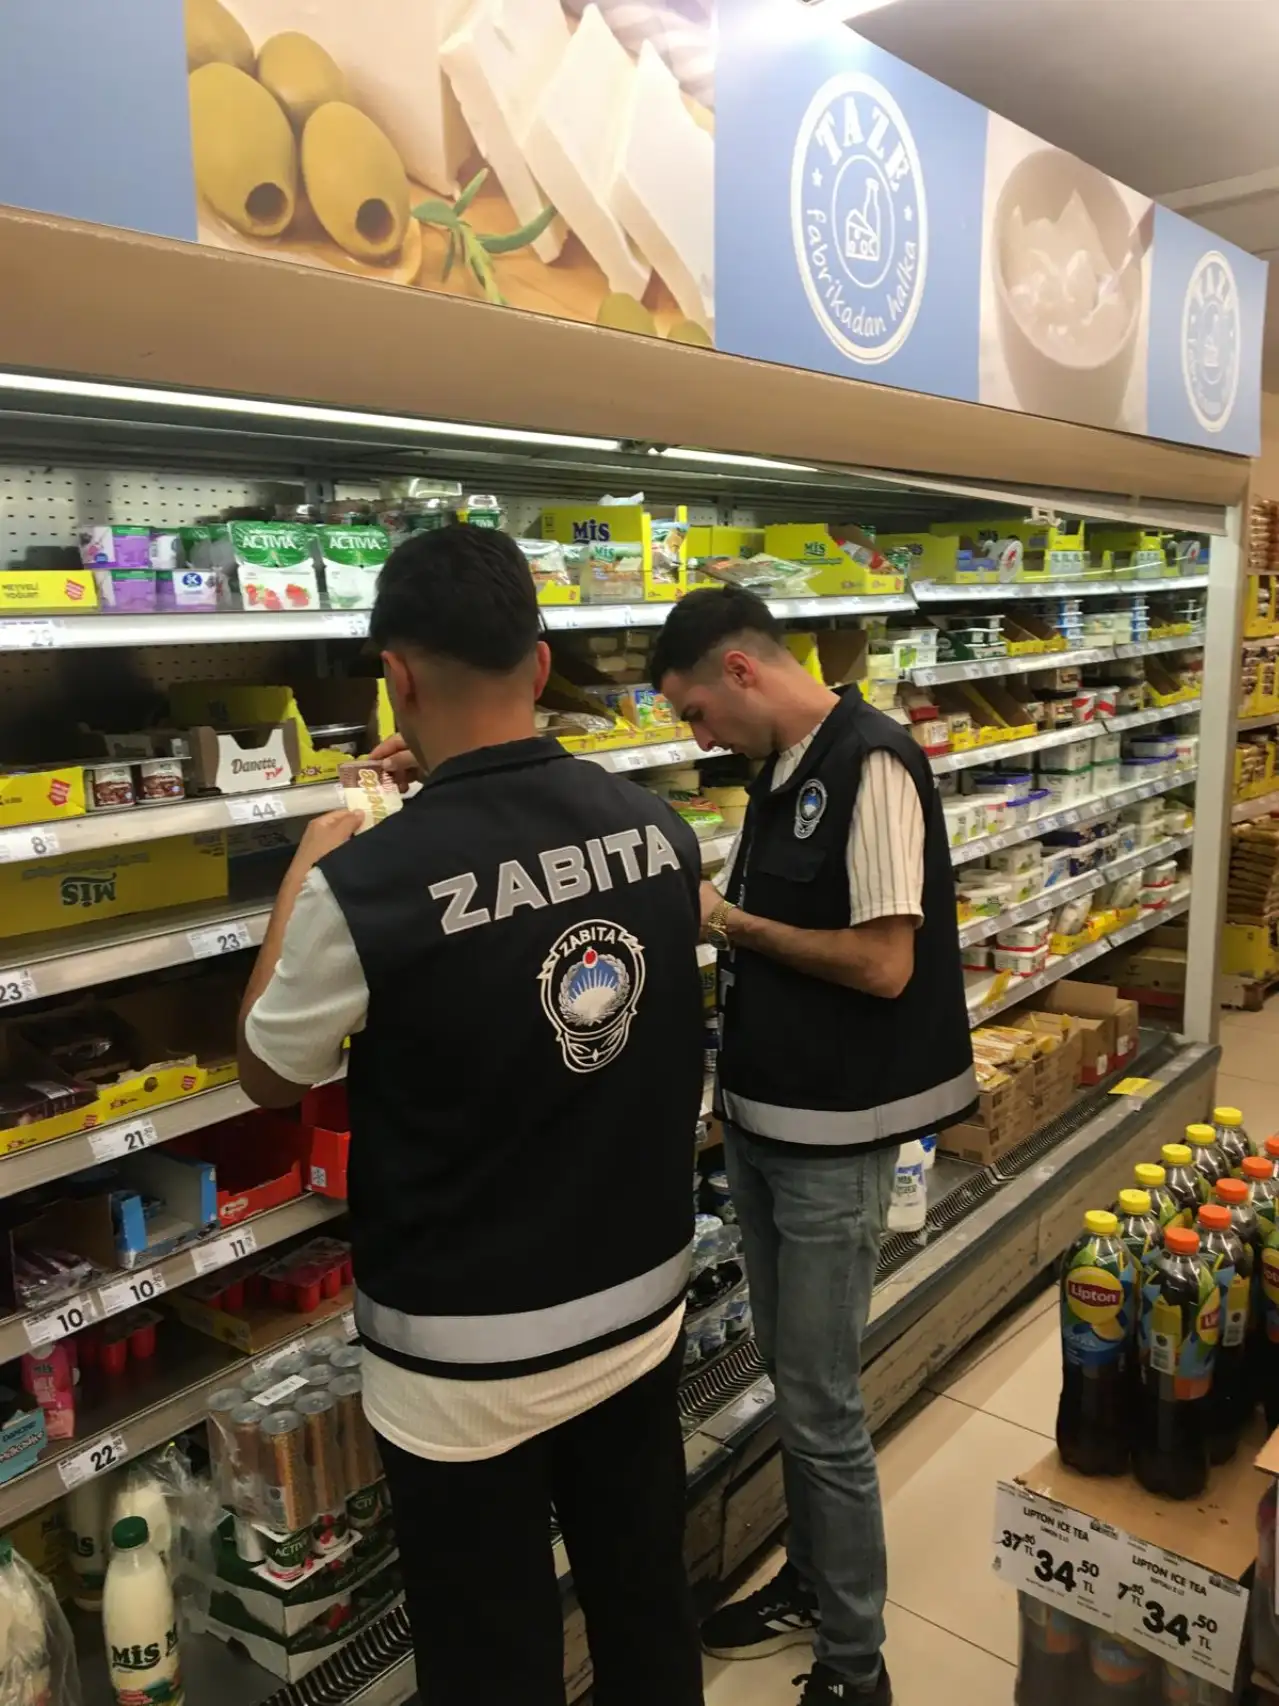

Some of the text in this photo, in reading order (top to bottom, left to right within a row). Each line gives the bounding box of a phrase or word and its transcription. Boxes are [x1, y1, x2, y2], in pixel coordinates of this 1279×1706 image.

[886, 241, 917, 321] halka
[242, 534, 297, 549] ACTIVIA
[330, 537, 381, 550] ACTIVIA
[231, 757, 276, 774] Danette
[252, 802, 276, 818] 44
[31, 836, 47, 854] 8
[427, 824, 681, 936] ZABITA
[217, 933, 241, 951] 23
[559, 926, 616, 958] ZABITA
[124, 1130, 145, 1151] 21
[230, 1239, 247, 1258] 11
[129, 1280, 154, 1301] 10
[1071, 1284, 1117, 1303] Lipton
[57, 1308, 84, 1332] 10
[90, 1445, 117, 1472] 22
[1023, 1506, 1055, 1527] LIPTON
[1057, 1521, 1071, 1534] ICE
[1073, 1526, 1089, 1542] TEA
[1001, 1529, 1021, 1551] 37
[1034, 1549, 1077, 1592] 34
[1132, 1554, 1169, 1578] LIPTON
[1171, 1573, 1186, 1588] ICE
[1188, 1581, 1207, 1597] TEA
[1083, 1580, 1095, 1595] TL
[1142, 1600, 1191, 1646] 34
[1198, 1635, 1212, 1651] TL
